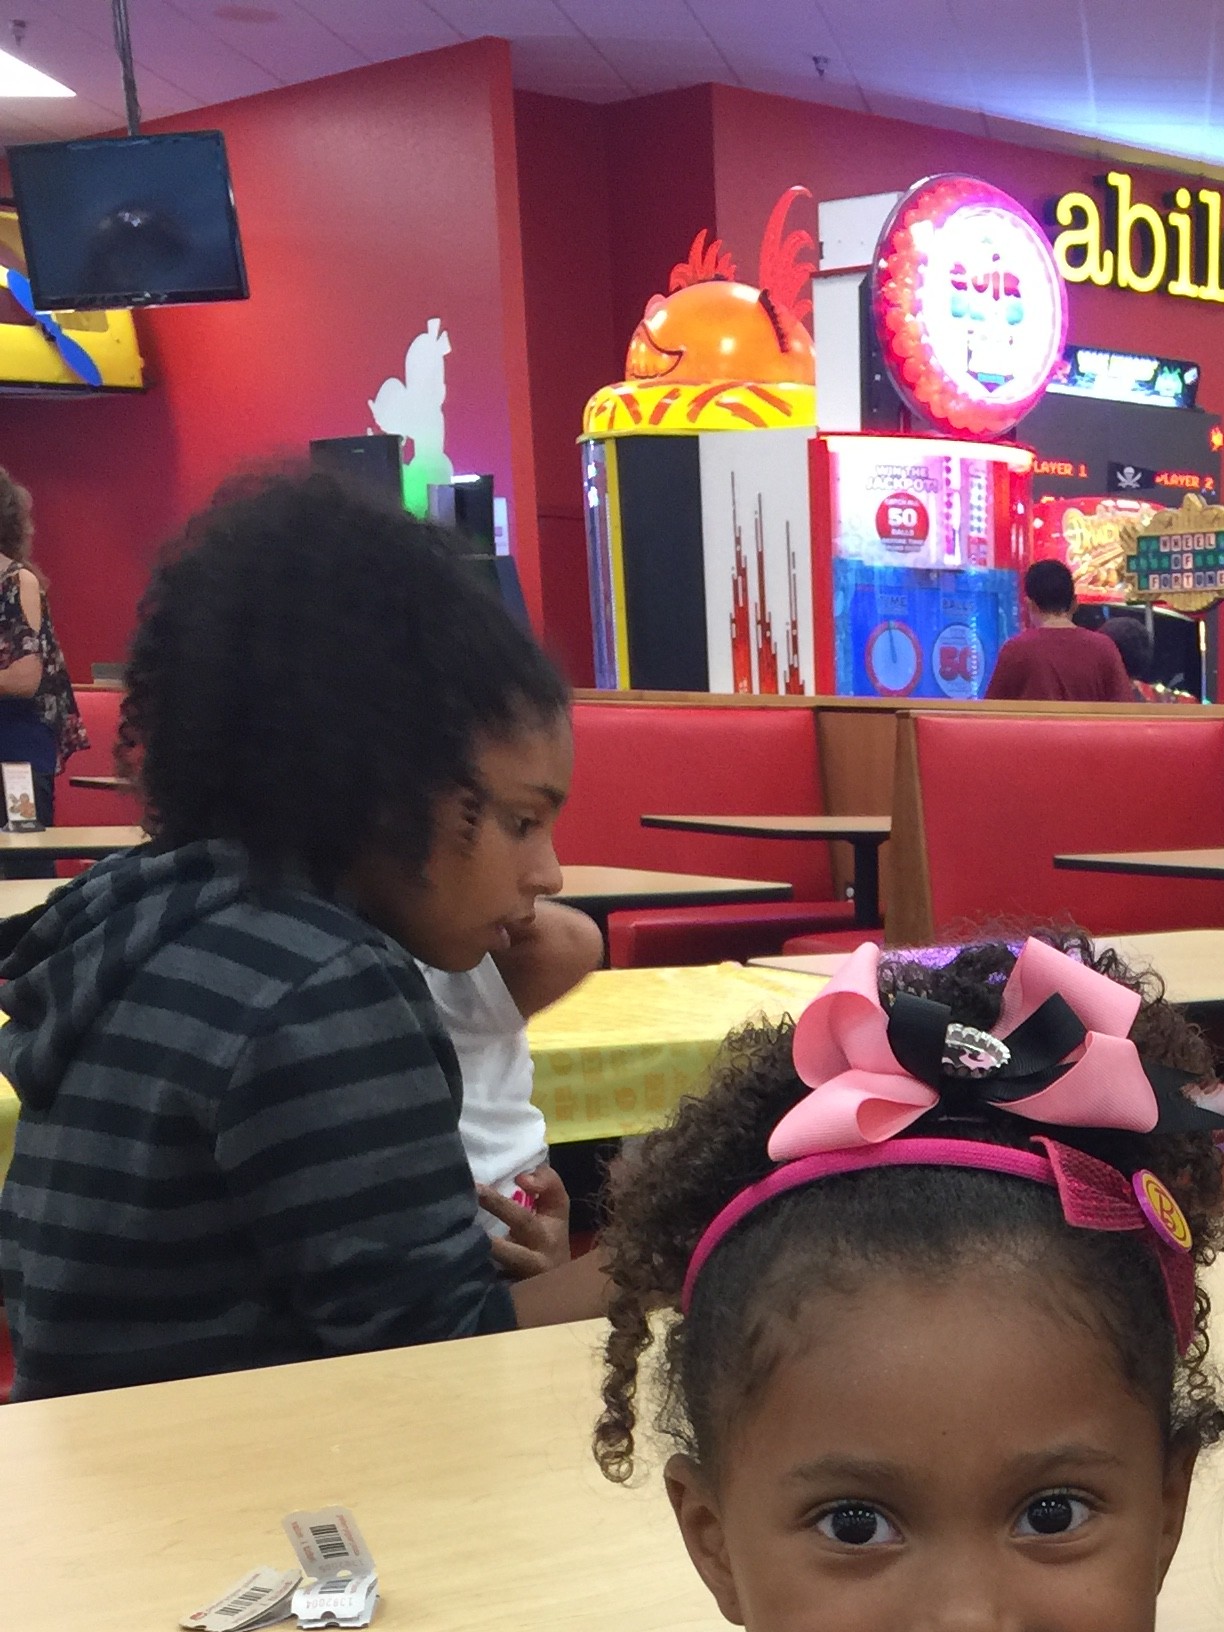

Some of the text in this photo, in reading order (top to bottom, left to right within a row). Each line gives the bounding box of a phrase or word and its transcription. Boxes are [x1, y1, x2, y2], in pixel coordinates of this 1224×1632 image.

[1033, 460, 1087, 477] LAYER 1
[1204, 477, 1213, 490] 2
[888, 507, 918, 528] 50
[1161, 534, 1215, 551] WHEEL
[1172, 554, 1192, 569] OF
